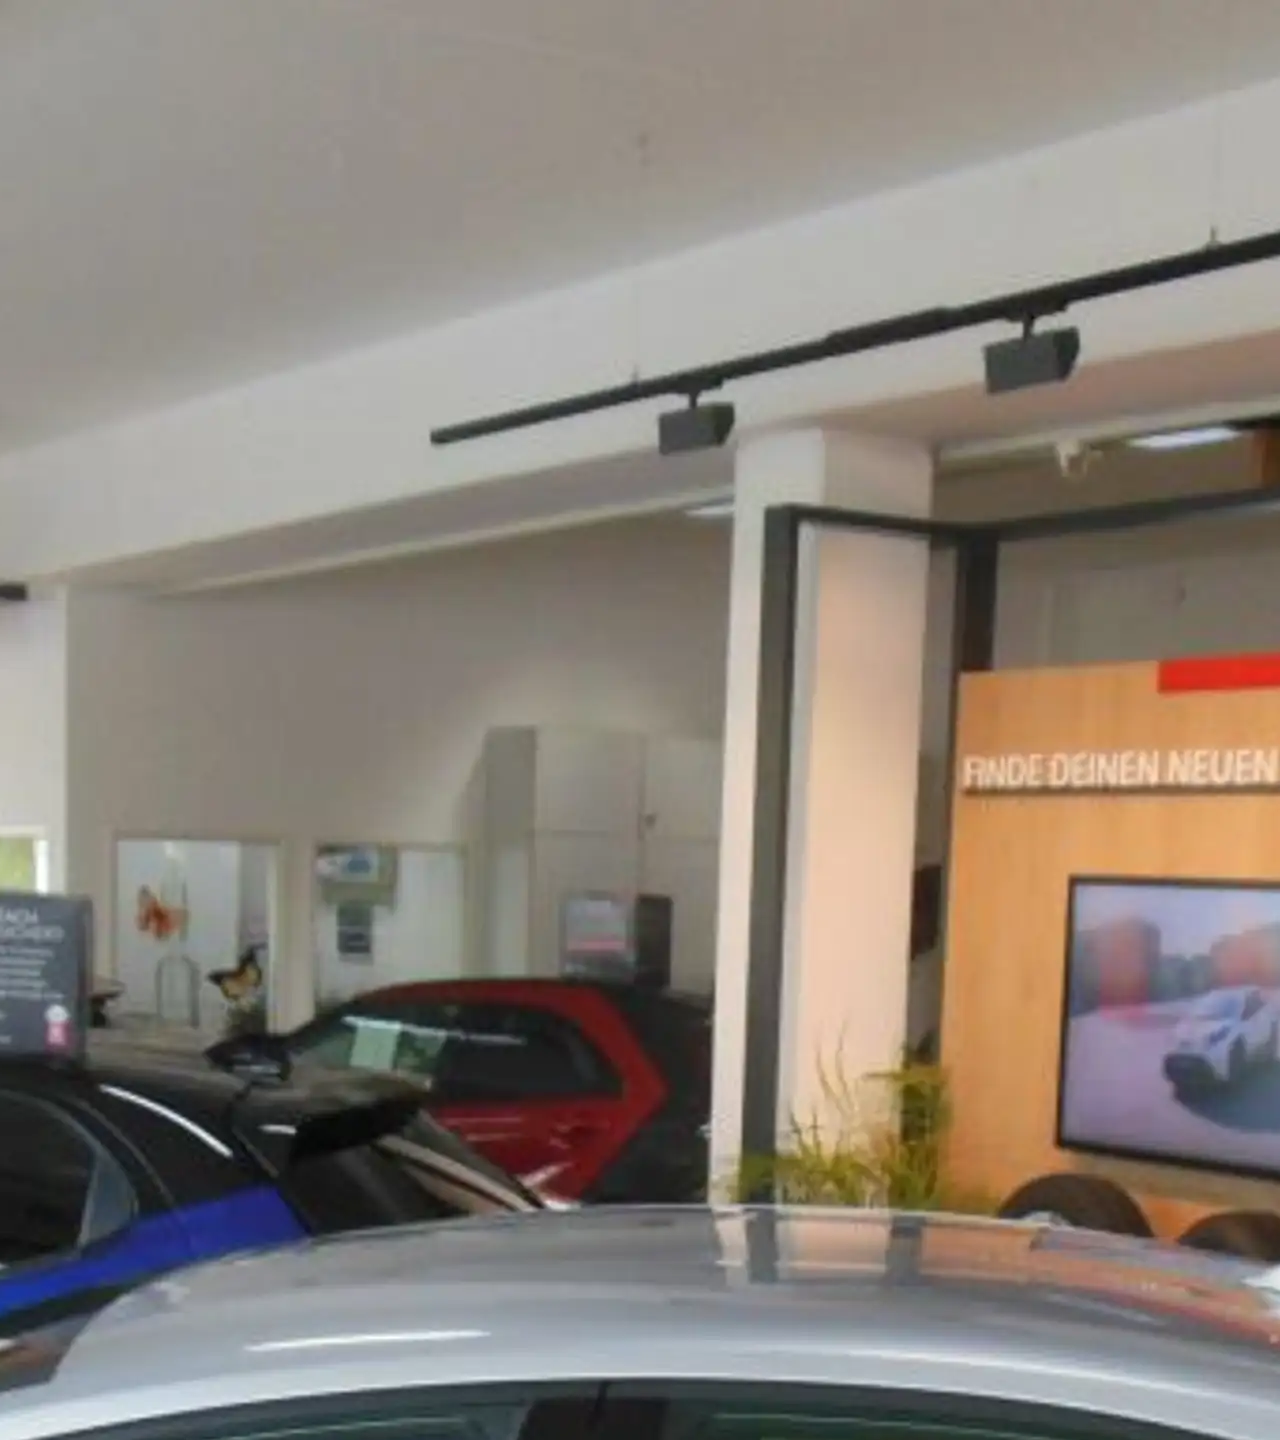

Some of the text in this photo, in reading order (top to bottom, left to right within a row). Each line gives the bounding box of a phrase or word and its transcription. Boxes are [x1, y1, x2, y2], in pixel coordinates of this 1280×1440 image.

[964, 754, 1042, 788] FINDE
[1048, 751, 1159, 787] DEINEN
[1167, 750, 1278, 785] NEUEN
